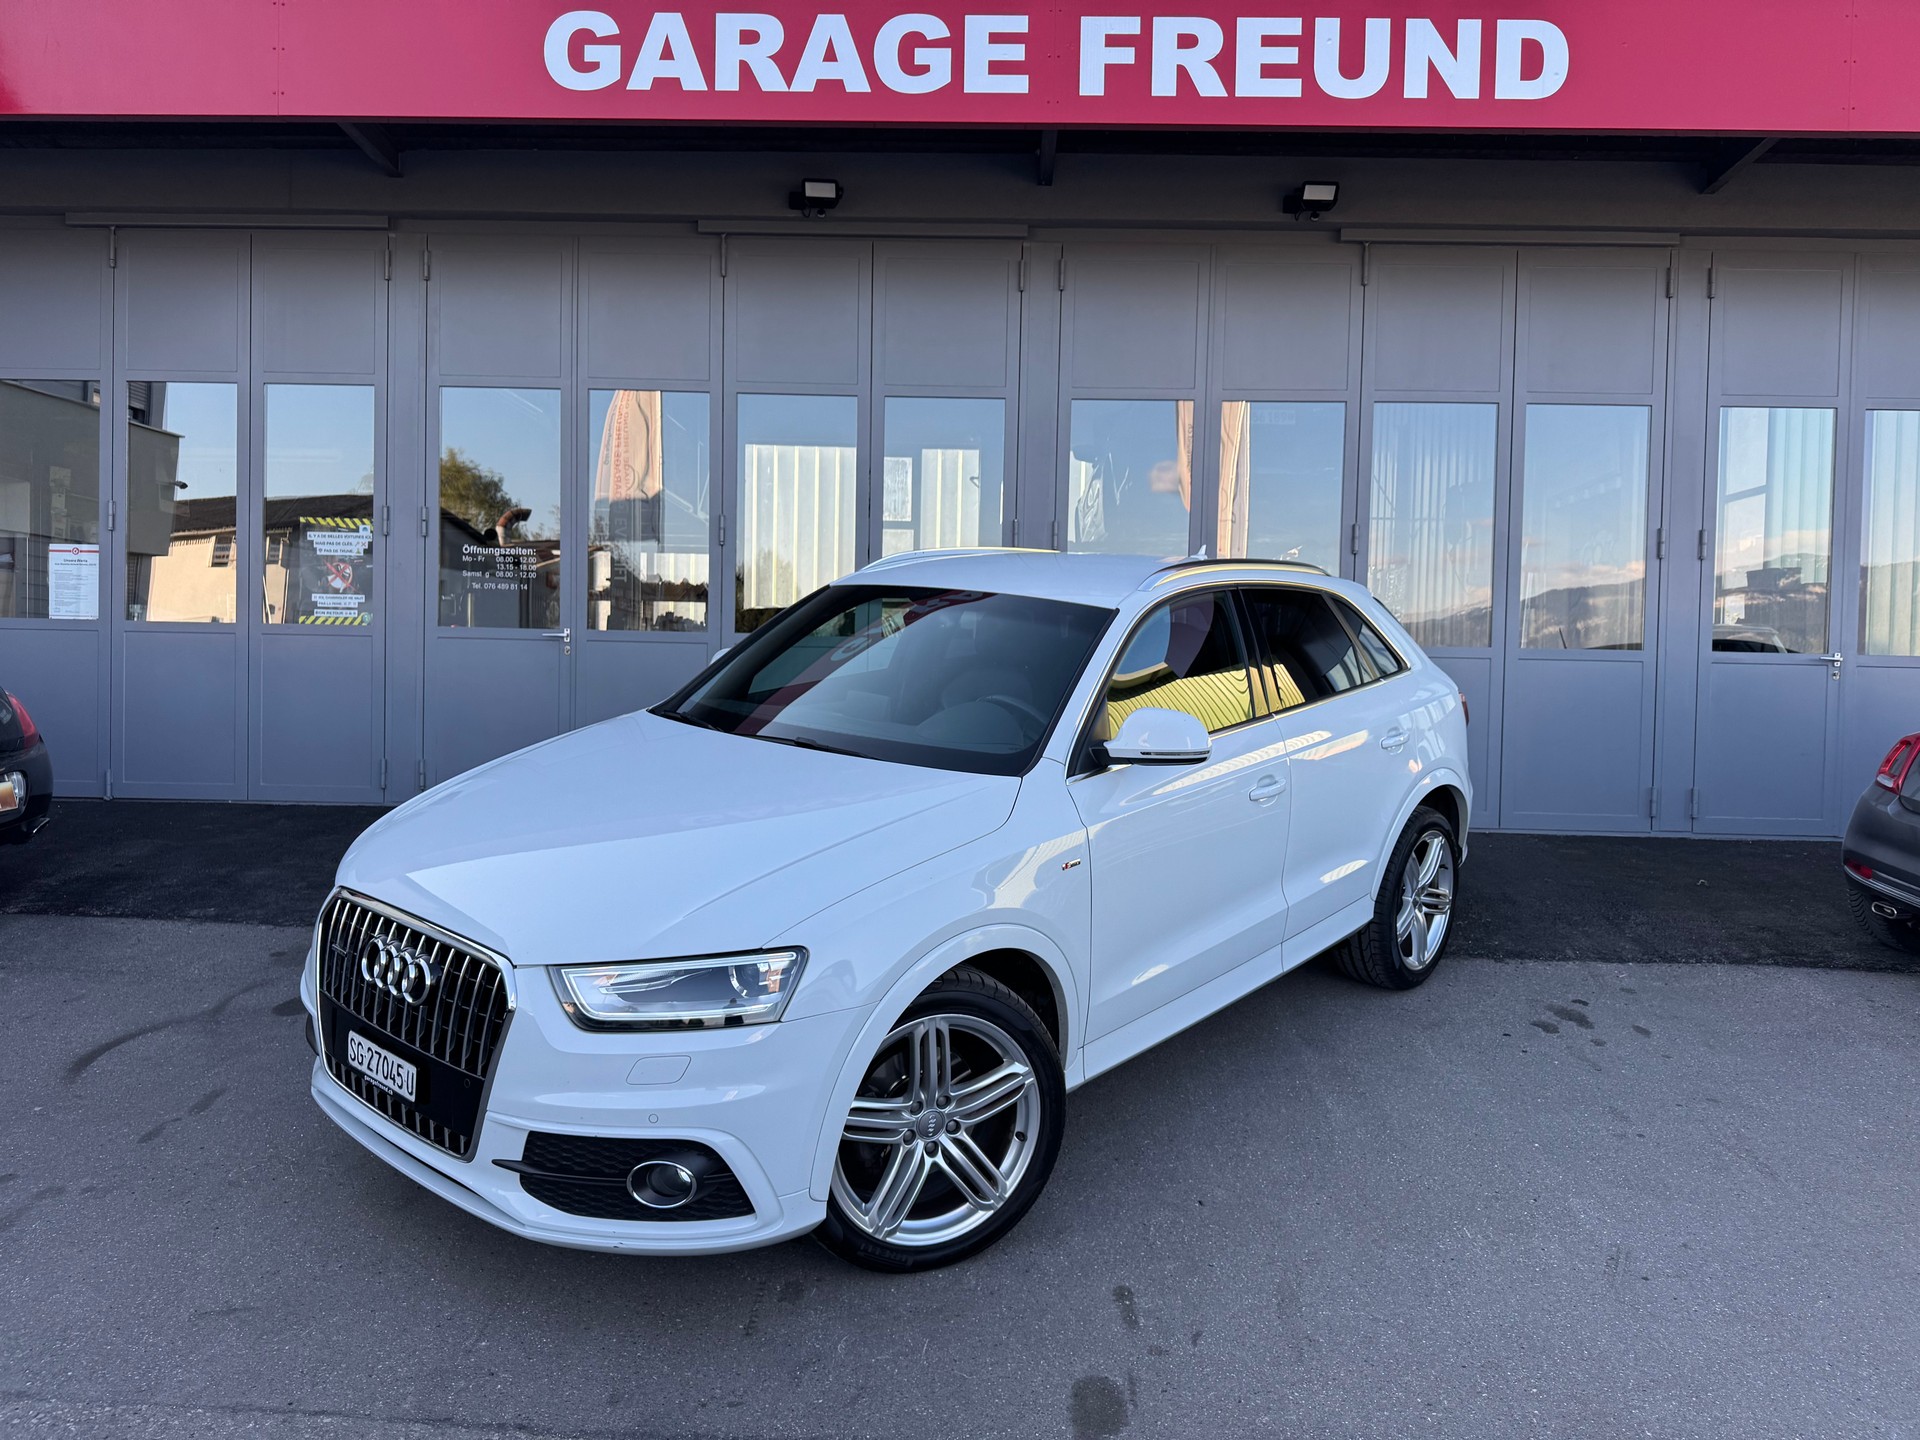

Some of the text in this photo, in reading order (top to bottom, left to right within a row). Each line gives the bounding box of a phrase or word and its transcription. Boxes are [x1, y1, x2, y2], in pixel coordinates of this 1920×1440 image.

[544, 11, 1569, 99] GARAGE FREUND
[462, 543, 537, 556] Öffnungszeiten:
[496, 563, 514, 571] 13.15
[462, 570, 490, 579] Samstg
[471, 582, 483, 590] Tel.
[483, 582, 496, 590] 076
